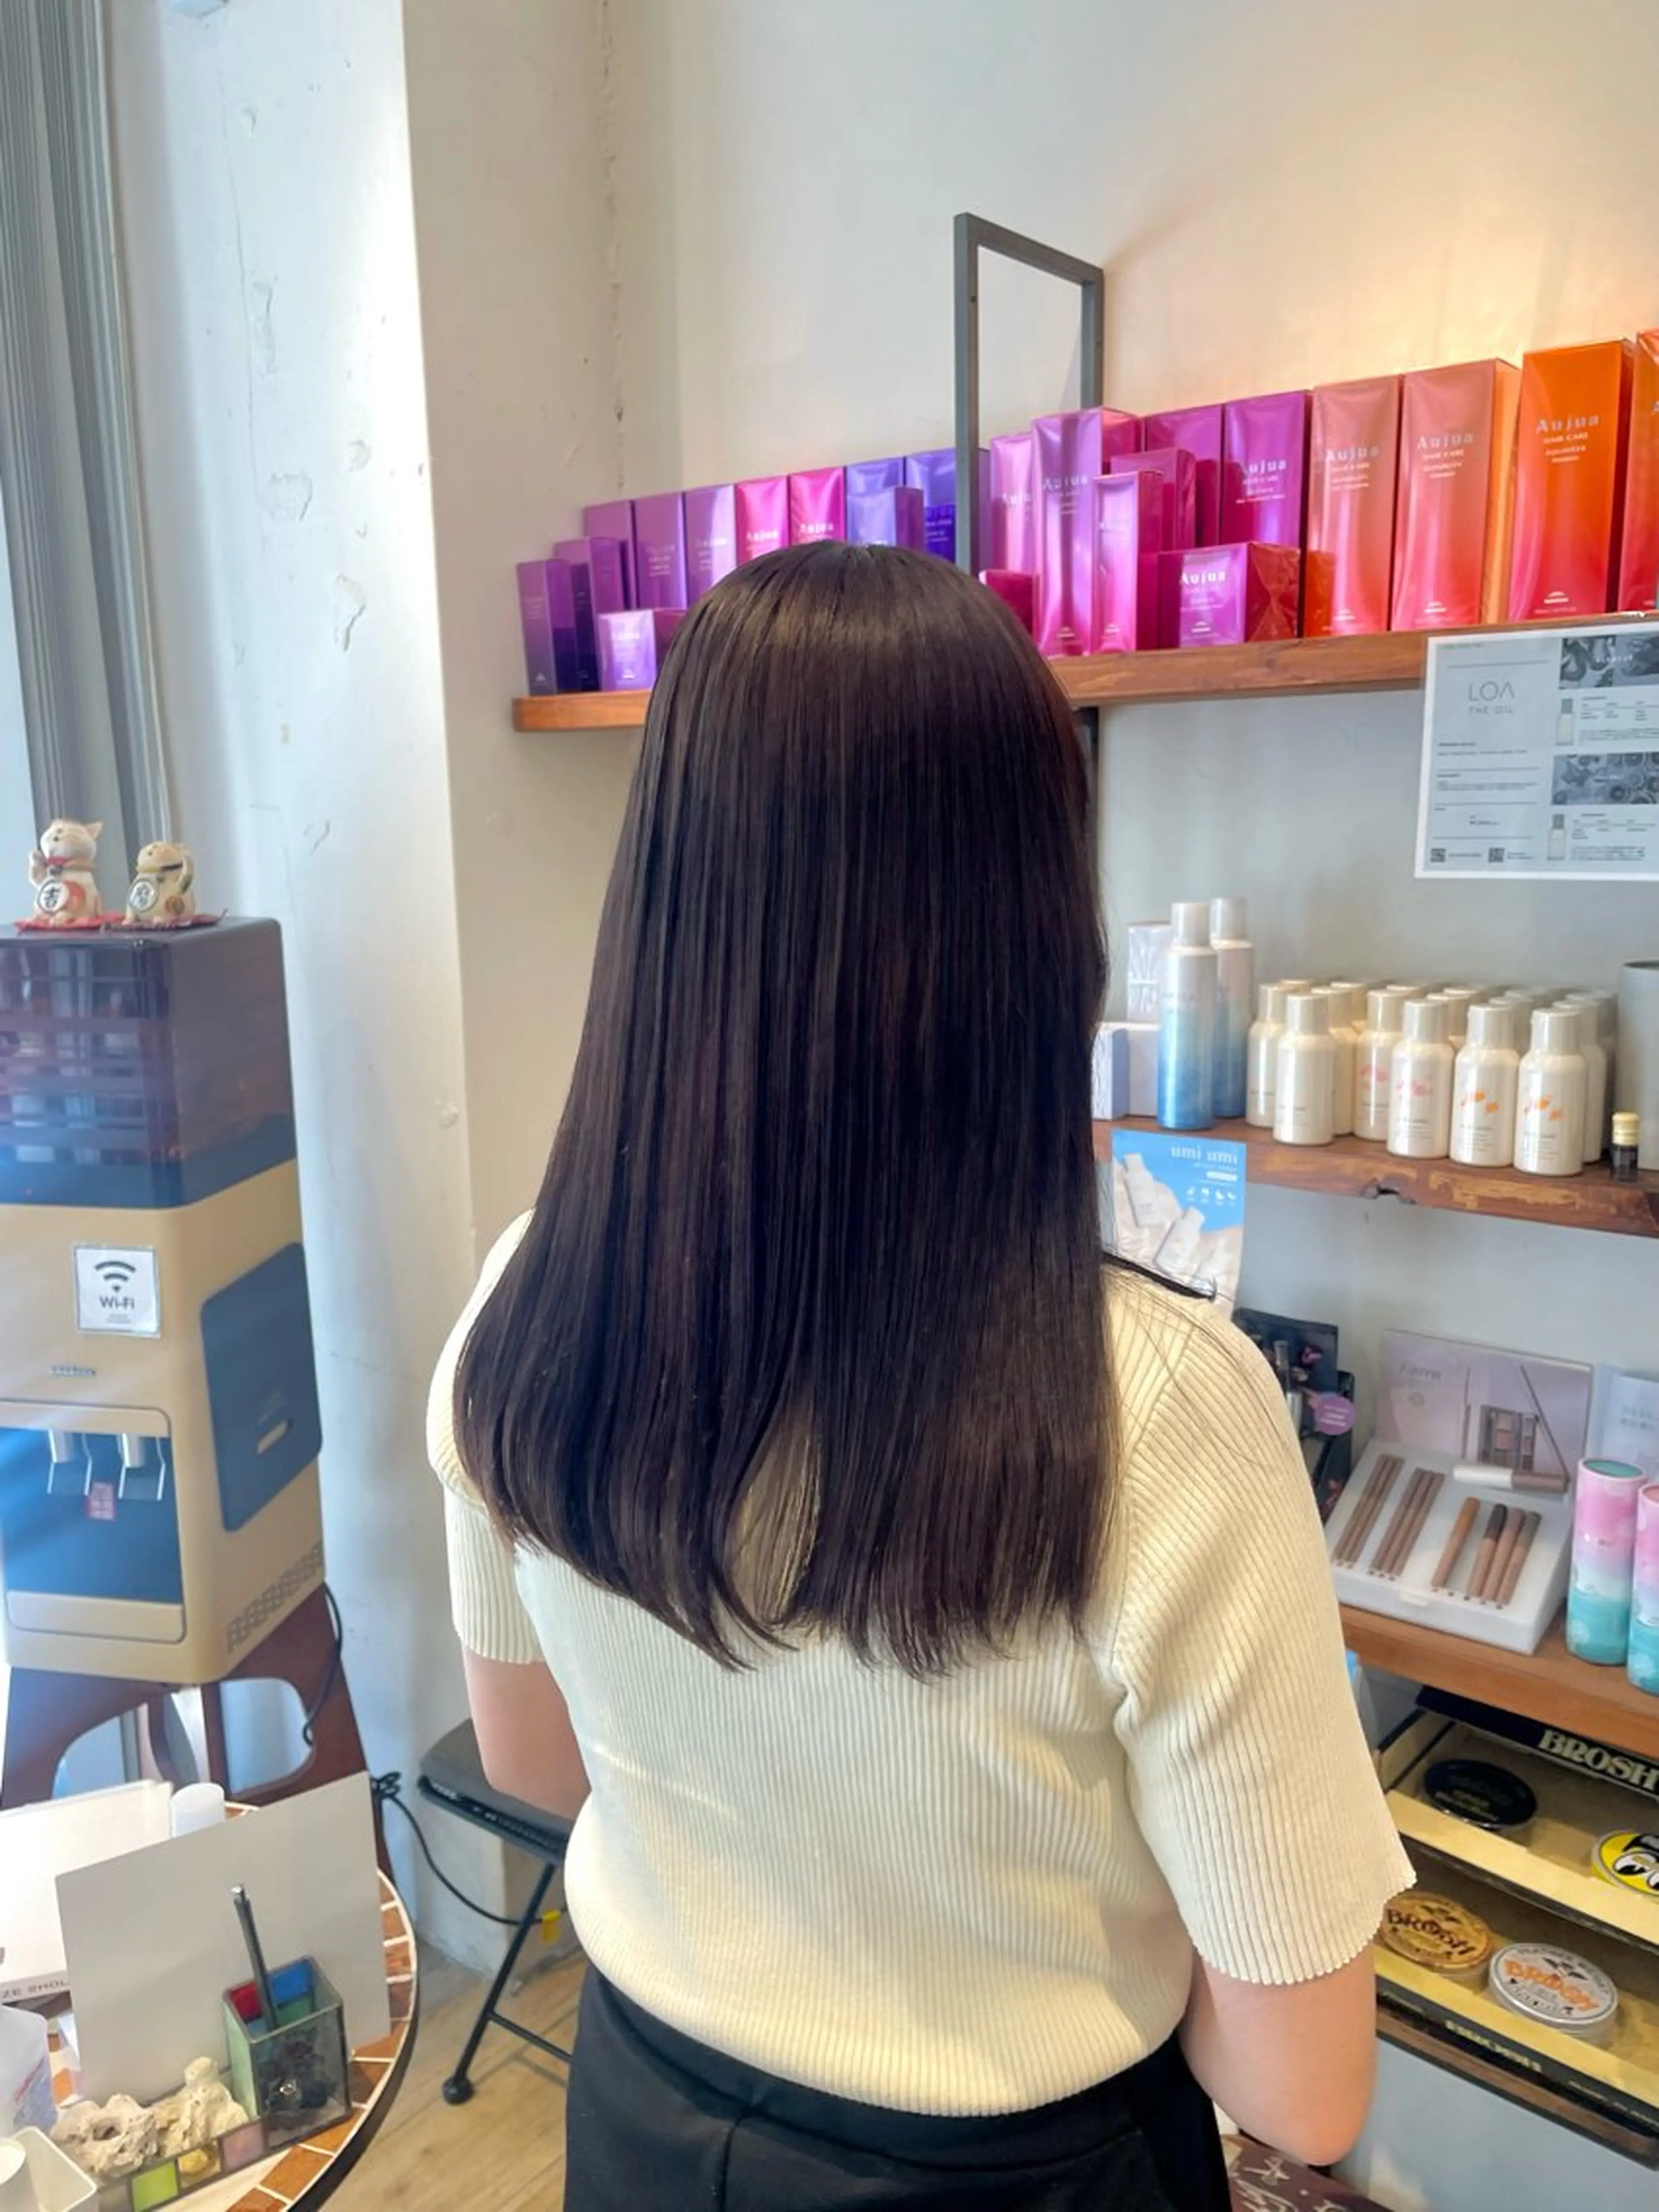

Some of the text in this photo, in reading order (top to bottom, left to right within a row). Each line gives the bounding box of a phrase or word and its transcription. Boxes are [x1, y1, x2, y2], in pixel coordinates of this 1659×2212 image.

[1171, 1145, 1201, 1160] umi
[99, 1295, 135, 1310] Wi-Fi
[1538, 1729, 1659, 1791] BROSH
